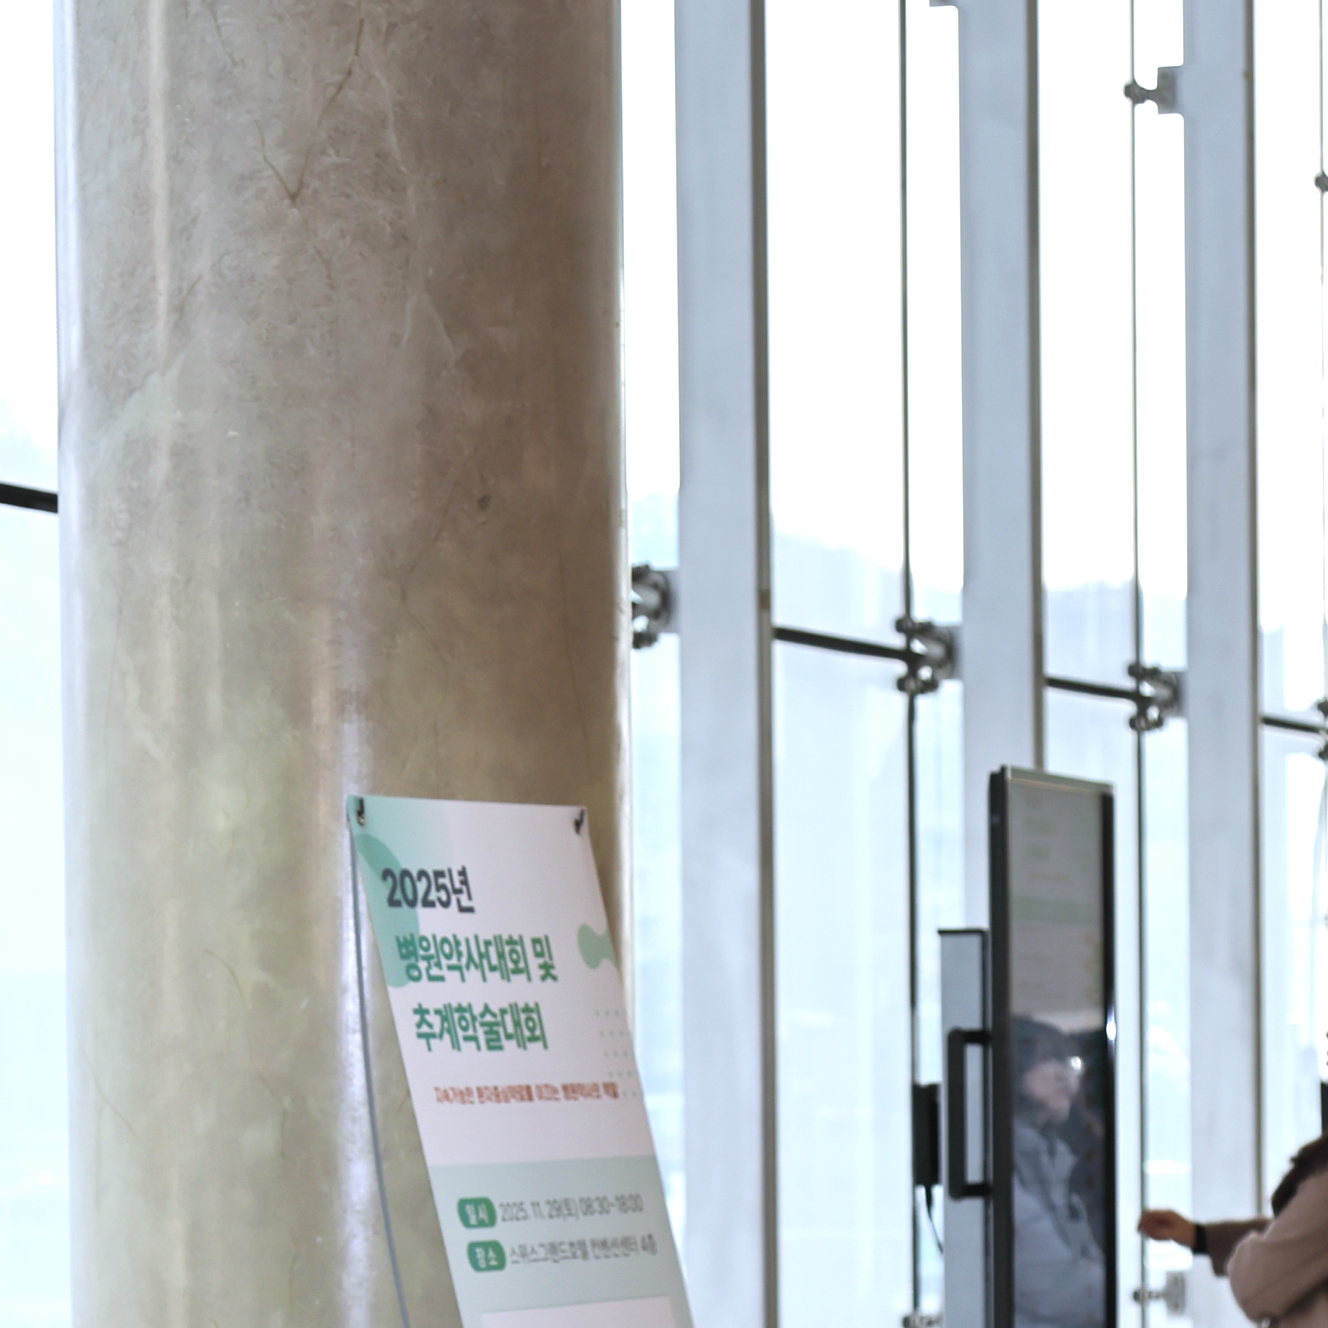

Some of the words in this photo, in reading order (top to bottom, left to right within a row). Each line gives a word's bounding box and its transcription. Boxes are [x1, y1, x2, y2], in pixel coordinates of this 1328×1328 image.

[381, 865, 476, 914] 2025년
[395, 932, 532, 984] 병원약사대회
[532, 934, 559, 983] 및
[412, 1002, 549, 1053] 추계학술대회
